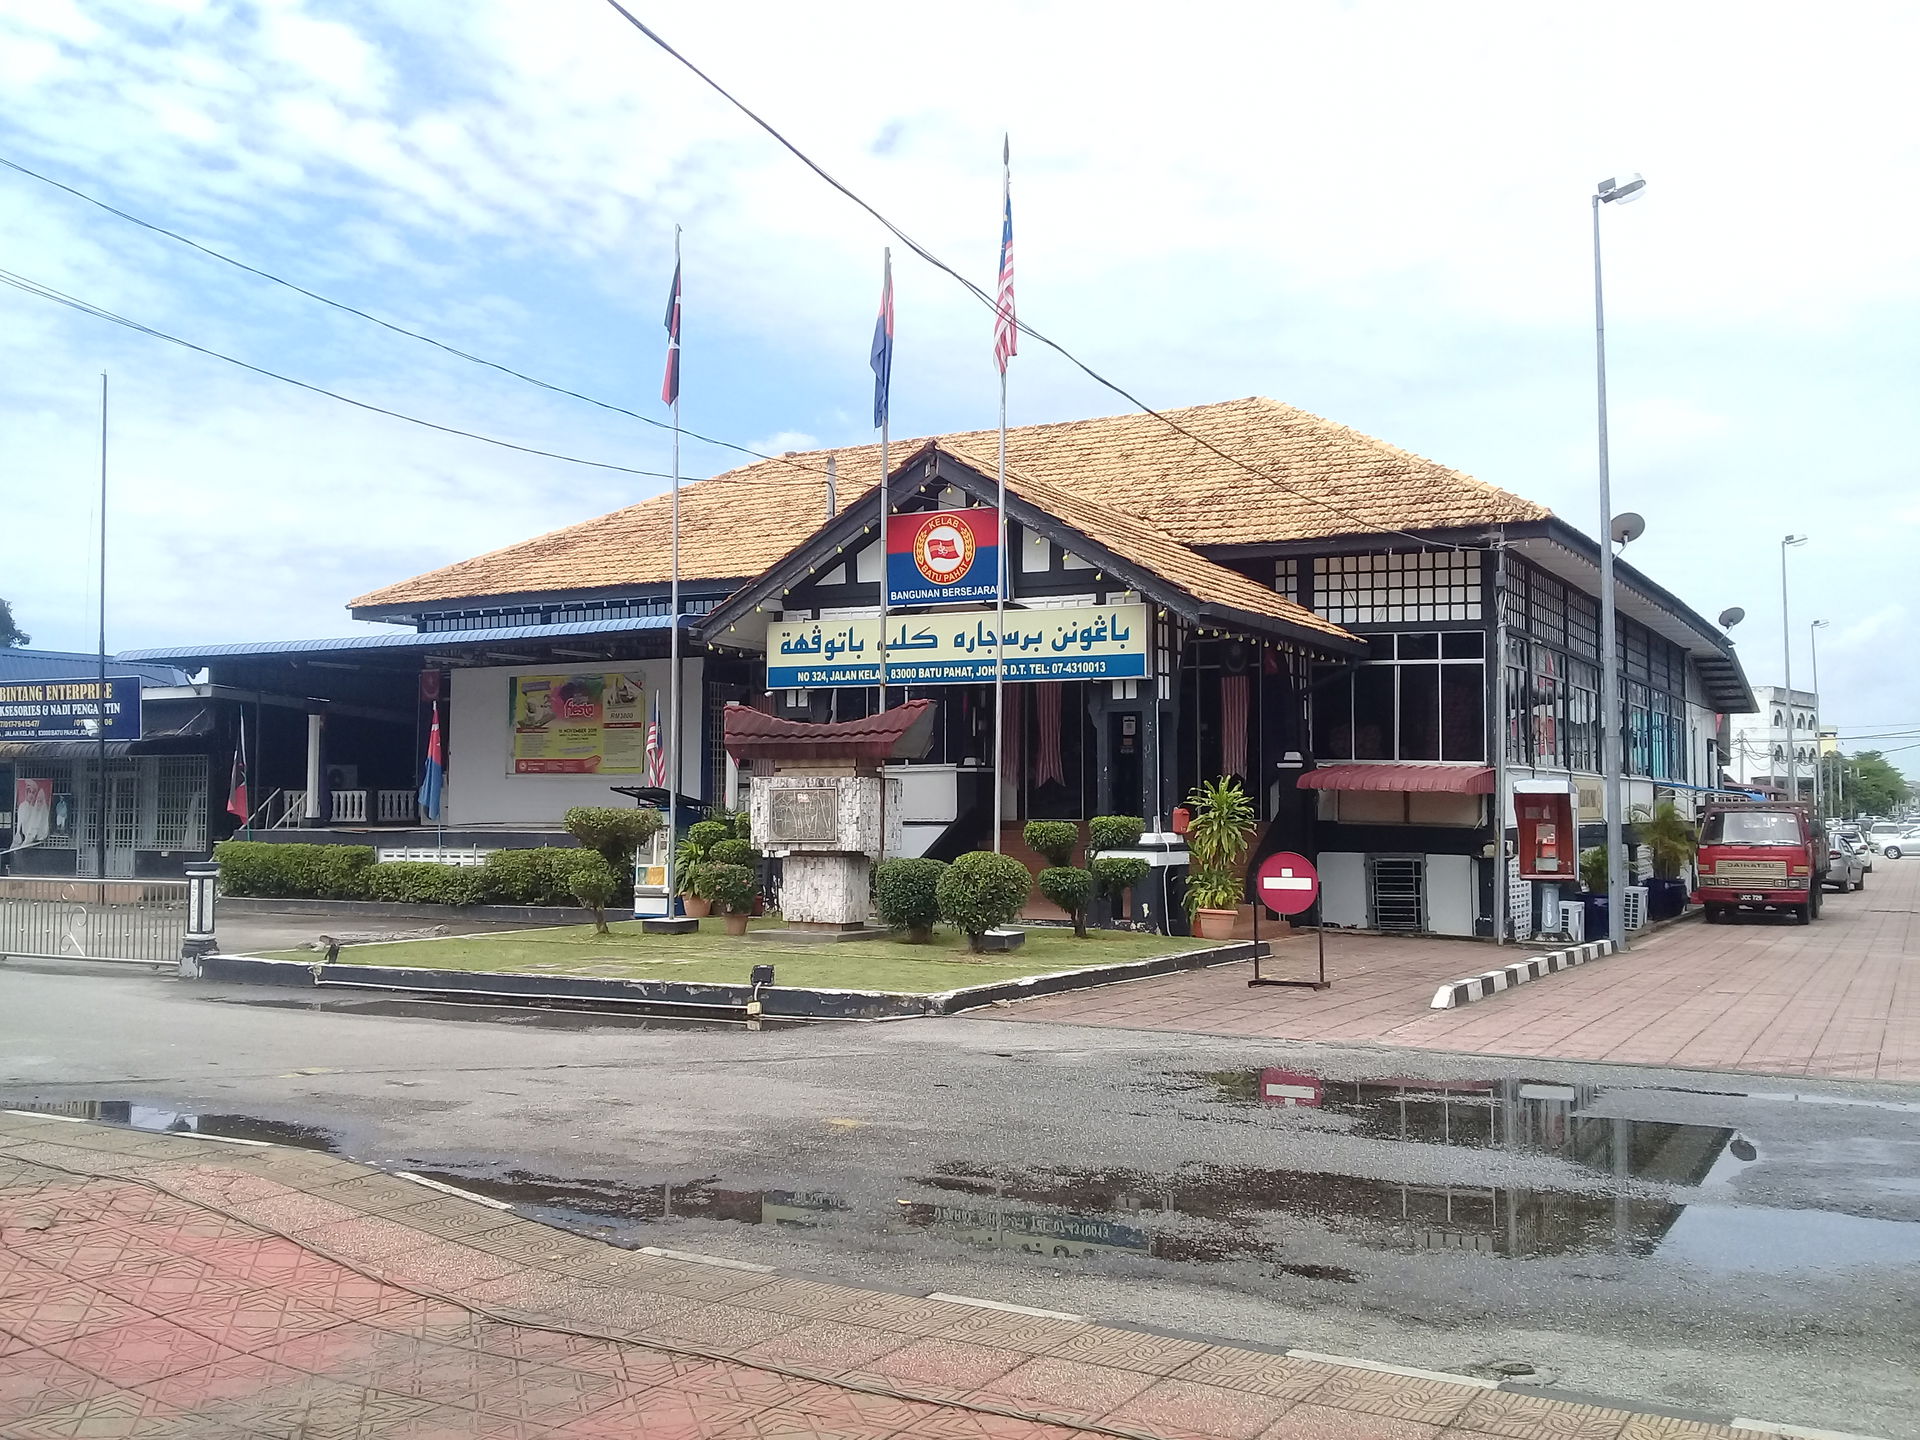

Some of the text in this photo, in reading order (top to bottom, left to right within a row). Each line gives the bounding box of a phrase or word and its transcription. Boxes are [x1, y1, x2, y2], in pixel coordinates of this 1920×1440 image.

[928, 517, 960, 530] KELAB
[921, 561, 969, 583] BATU PAHAT
[890, 585, 999, 601] BANGUNAN BERSEJARA
[797, 671, 809, 682] NO
[811, 670, 829, 683] 324,
[829, 669, 857, 681] JALAN
[858, 668, 890, 682] KELA,
[890, 667, 917, 679] 83000
[918, 666, 942, 678] BATU
[943, 665, 975, 680] PAHAT,
[1010, 663, 1027, 676] D.T.
[1029, 663, 1050, 675] TEL:
[1051, 661, 1107, 674] 07-4310013
[0, 682, 113, 702] BINTANG ENTERPRIE
[42, 704, 49, 716] &
[50, 704, 71, 716] NADI
[72, 702, 121, 716] PENGATIN
[564, 697, 595, 719] fiesta
